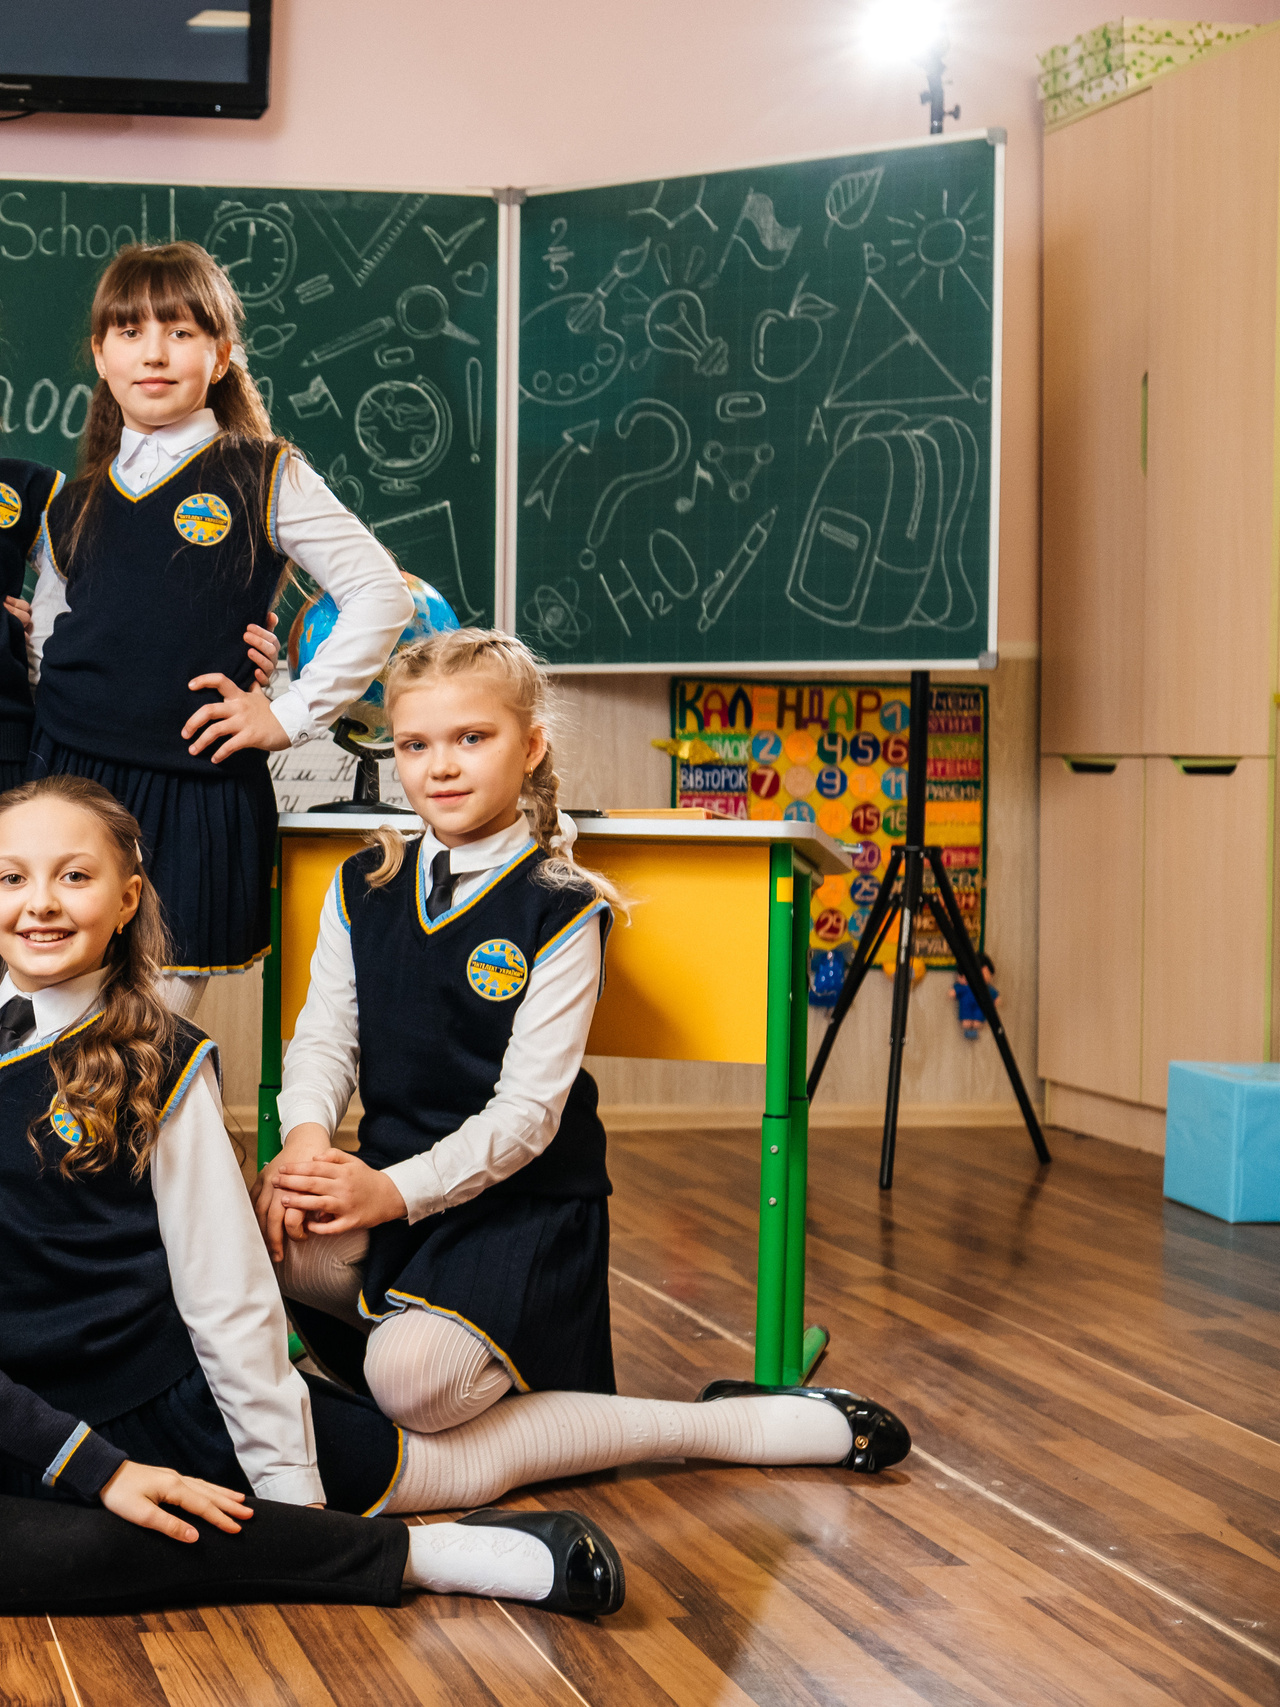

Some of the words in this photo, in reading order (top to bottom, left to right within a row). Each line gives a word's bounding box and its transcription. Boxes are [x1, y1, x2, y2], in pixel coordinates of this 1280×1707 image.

[806, 405, 828, 445] A
[679, 684, 882, 731] КАЛЕНДАР
[883, 703, 902, 733] 1
[758, 730, 778, 761] 2
[823, 733, 843, 765] 4
[856, 734, 874, 764] 5
[888, 735, 909, 764] 6
[756, 768, 776, 797] 7
[821, 767, 842, 795] 9
[884, 771, 908, 797] 11
[852, 804, 879, 832] 15
[853, 880, 881, 901] 25
[818, 909, 845, 937] 29
